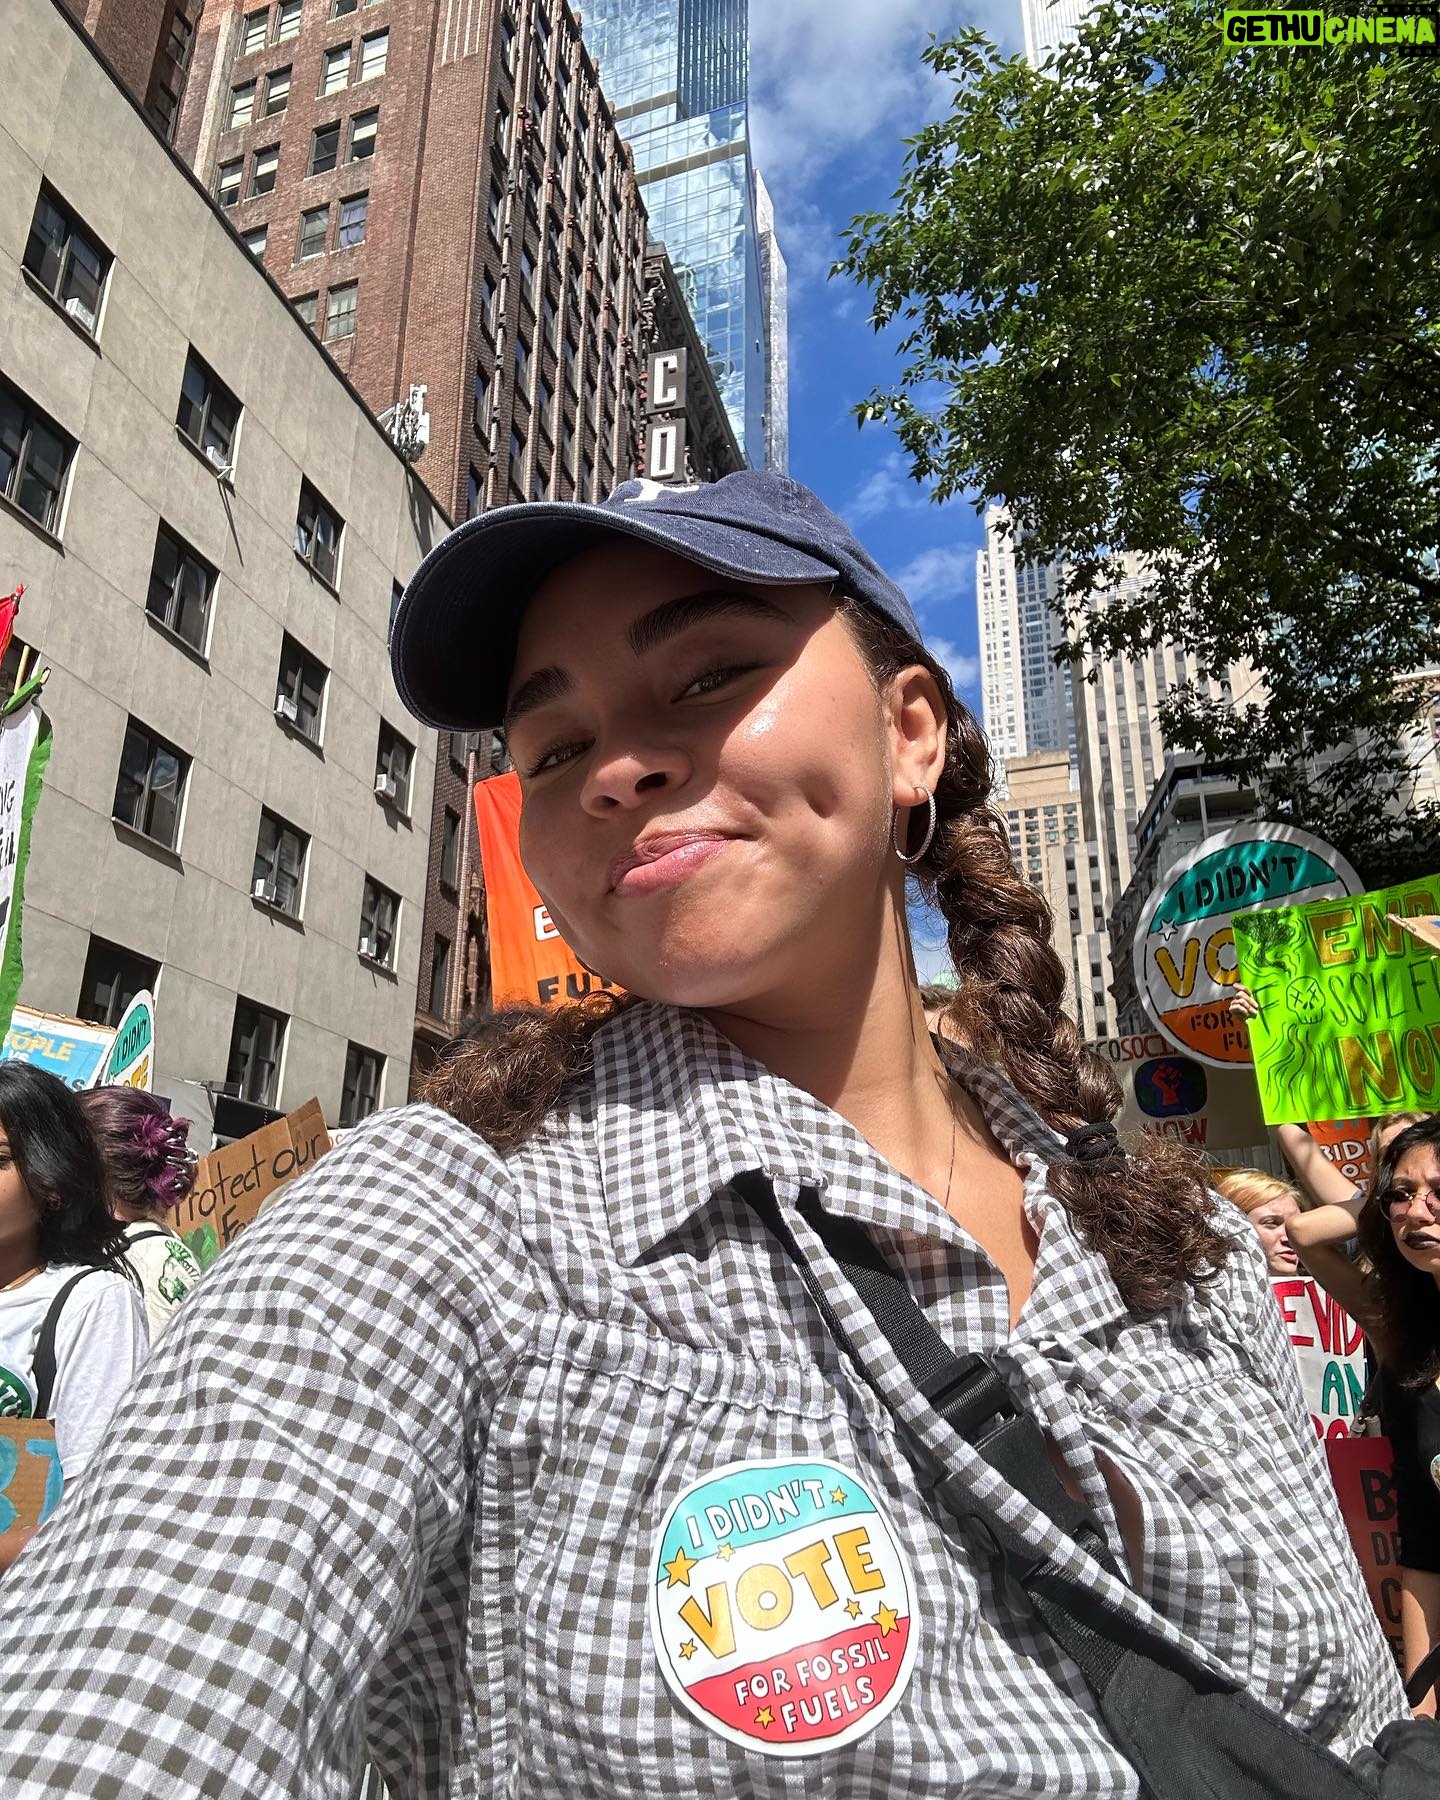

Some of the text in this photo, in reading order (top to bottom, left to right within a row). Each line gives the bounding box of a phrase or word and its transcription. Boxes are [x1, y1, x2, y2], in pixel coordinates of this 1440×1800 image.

[1177, 856, 1298, 913] I DIDN'T
[1154, 927, 1240, 998] VO
[1190, 1010, 1234, 1032] FOR
[272, 1133, 321, 1179] our
[686, 1479, 824, 1549] I DIDN'T
[678, 1526, 886, 1659] VOTE
[734, 1637, 890, 1706] FOR FOSSIL
[780, 1676, 876, 1734] FUELS
